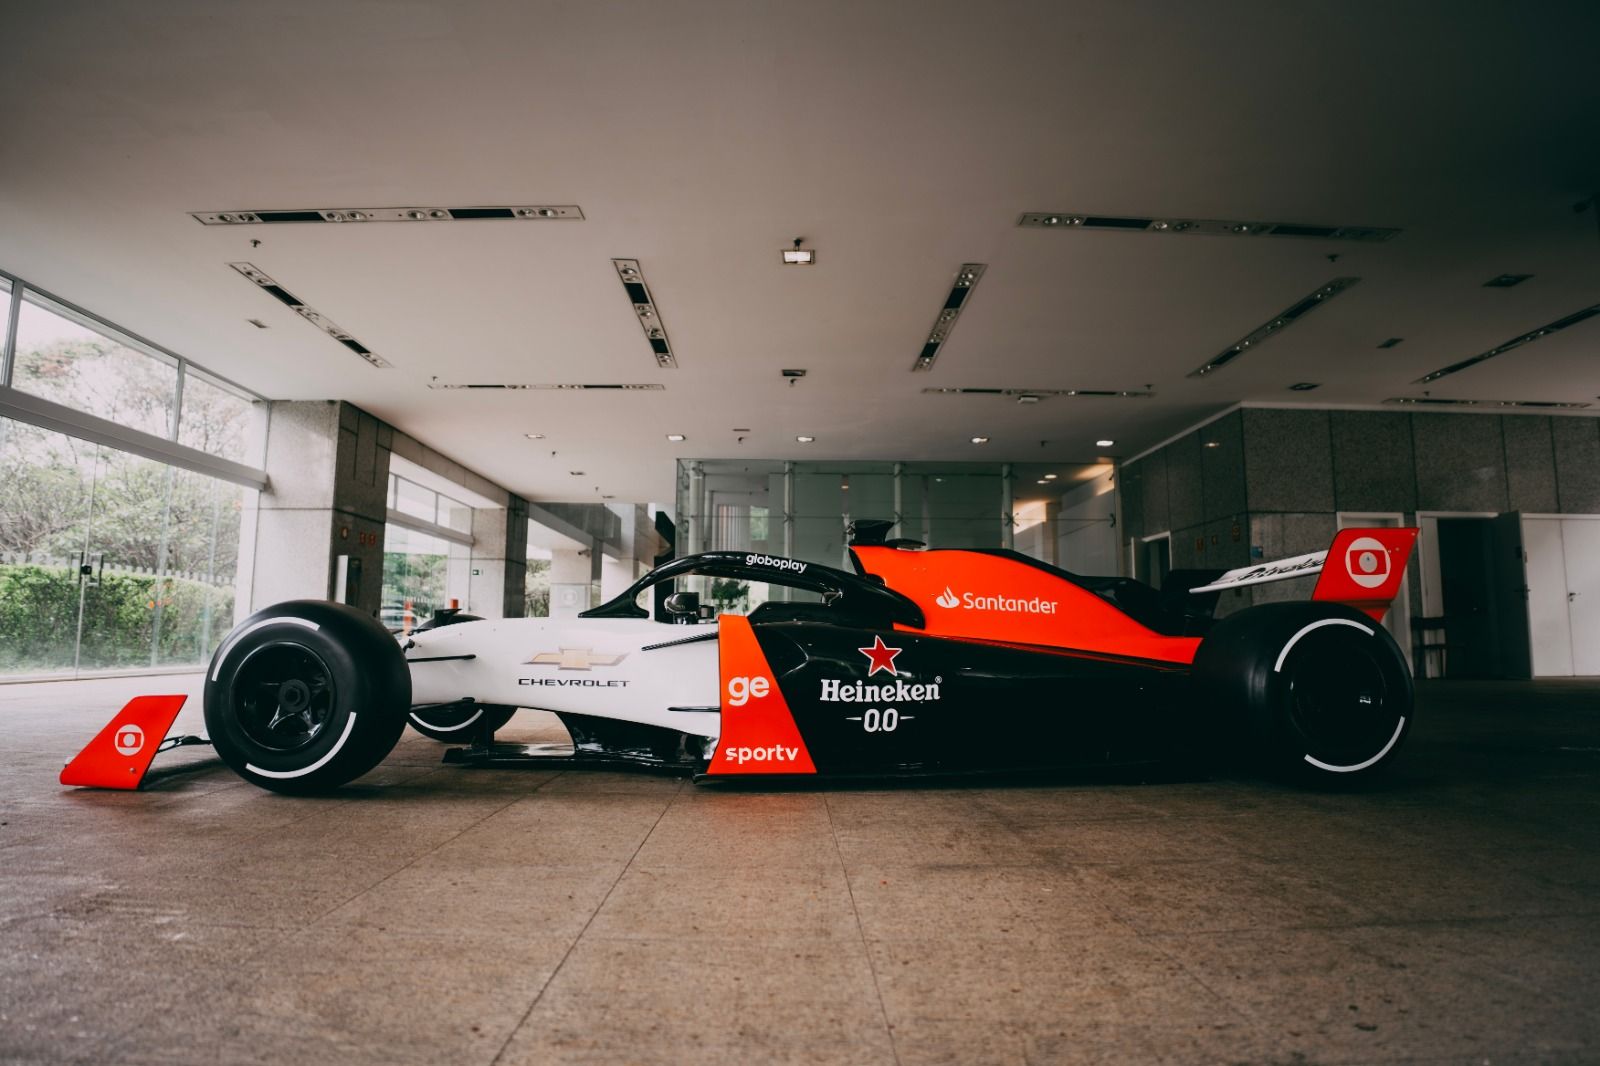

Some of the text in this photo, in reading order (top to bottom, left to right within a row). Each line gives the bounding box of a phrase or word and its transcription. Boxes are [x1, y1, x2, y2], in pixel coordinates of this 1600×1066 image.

[745, 553, 807, 574] globoplay
[963, 592, 1058, 614] Santander
[518, 678, 631, 688] CHEVROLET
[728, 676, 770, 706] ge
[725, 744, 799, 765] sportv
